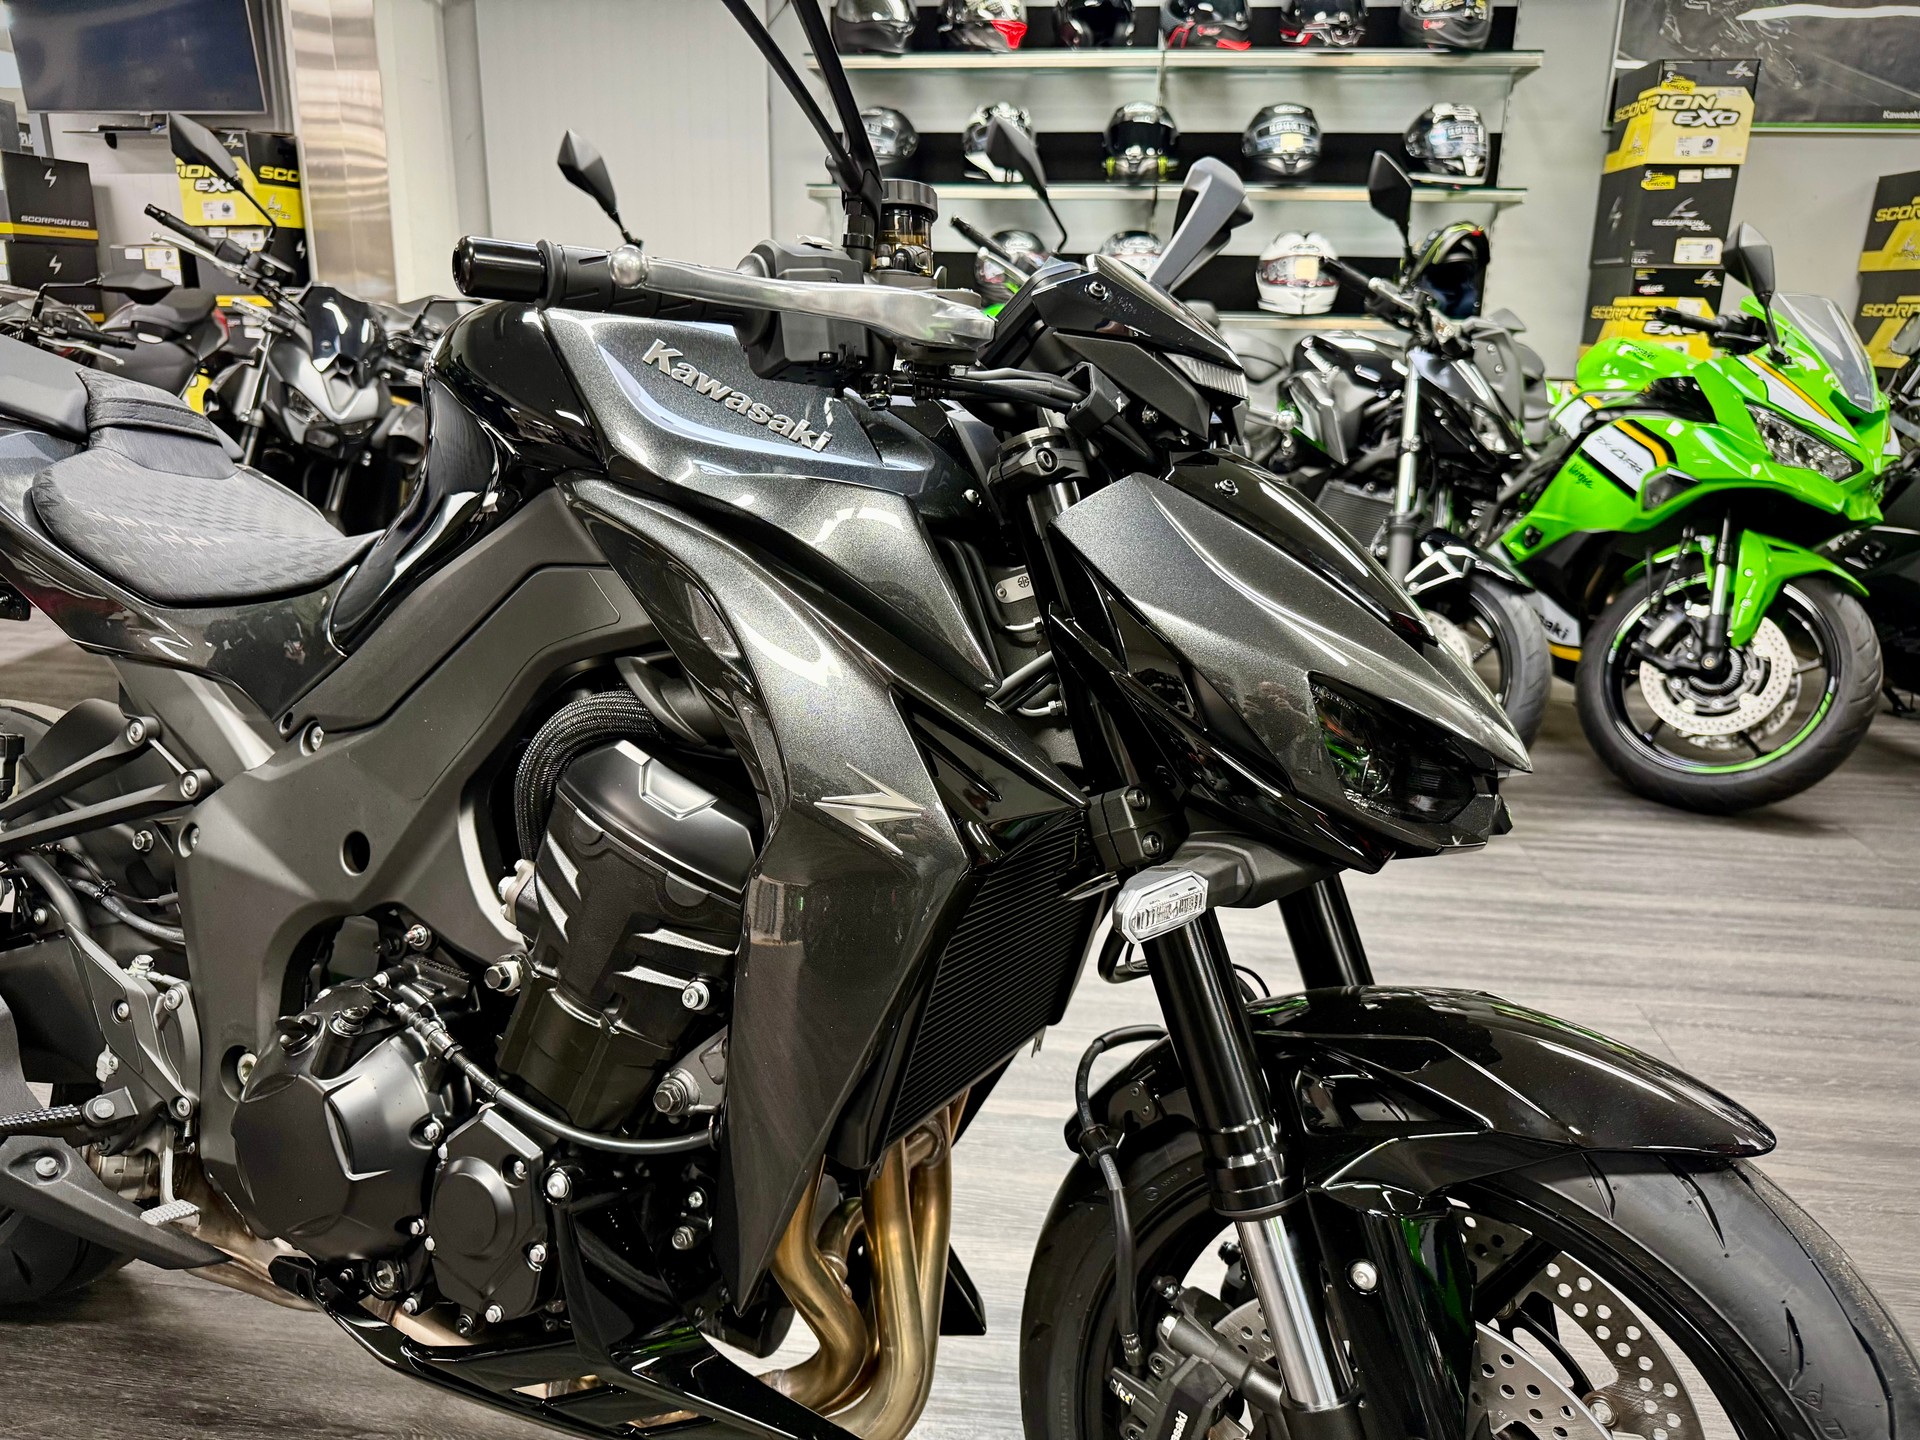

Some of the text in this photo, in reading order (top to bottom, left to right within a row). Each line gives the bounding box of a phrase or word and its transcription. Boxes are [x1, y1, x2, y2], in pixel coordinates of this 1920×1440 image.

[1614, 94, 1717, 122] SCORPION
[1673, 109, 1741, 127] EXO
[21, 215, 70, 226] SCORPION
[642, 338, 833, 453] Kawasaki
